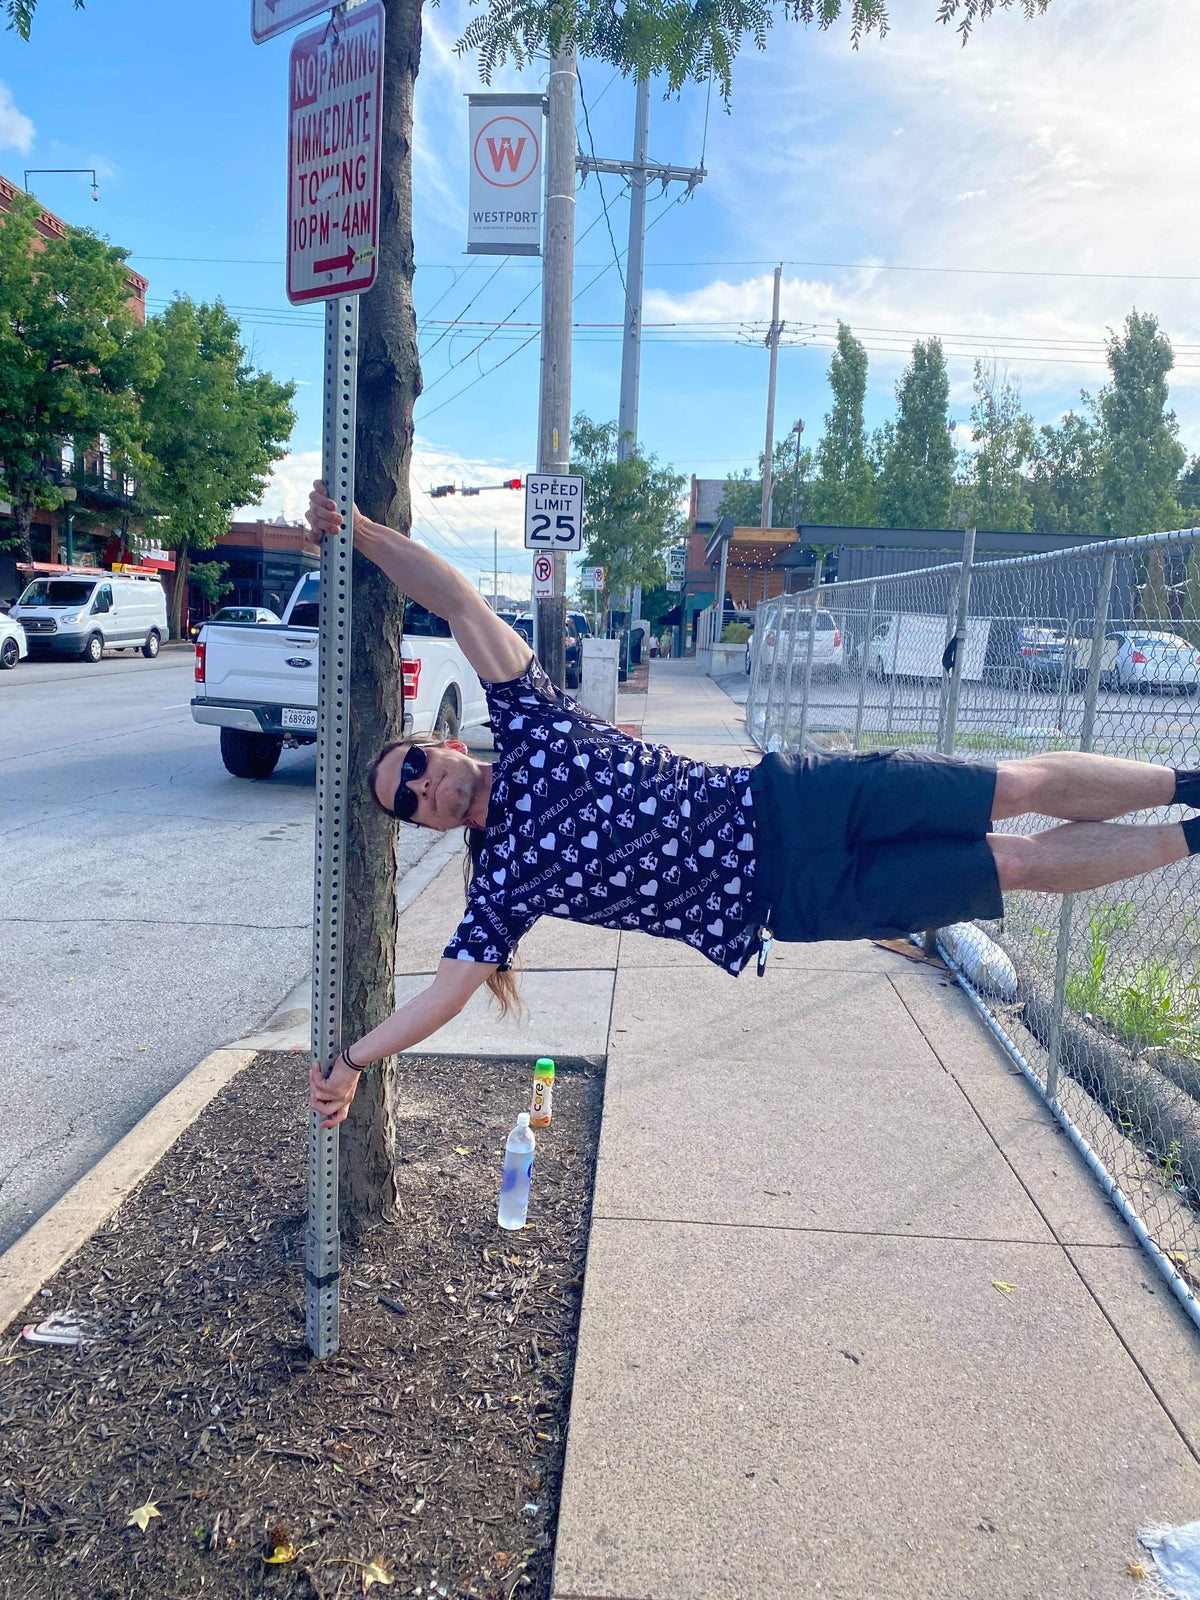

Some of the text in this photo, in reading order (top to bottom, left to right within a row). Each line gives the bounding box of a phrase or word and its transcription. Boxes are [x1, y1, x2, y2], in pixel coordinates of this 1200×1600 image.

[295, 27, 377, 101] NO PARKING
[297, 91, 371, 165] IMMEDIATE
[486, 136, 528, 172] W
[293, 198, 371, 252] 10PM-4AM
[473, 211, 538, 224] WESTPORT
[531, 483, 579, 496] SPEED
[535, 498, 573, 511] LIMIT
[531, 514, 575, 541] 25
[289, 714, 315, 725] 689289
[538, 780, 593, 826] SPREAD LOVE
[697, 804, 727, 833] SPREAD
[605, 827, 661, 864] WRLDWIDE
[511, 862, 562, 897] SPREAD LOVE
[663, 869, 720, 911] SPREAD LOVE
[480, 904, 508, 936] SPREAD
